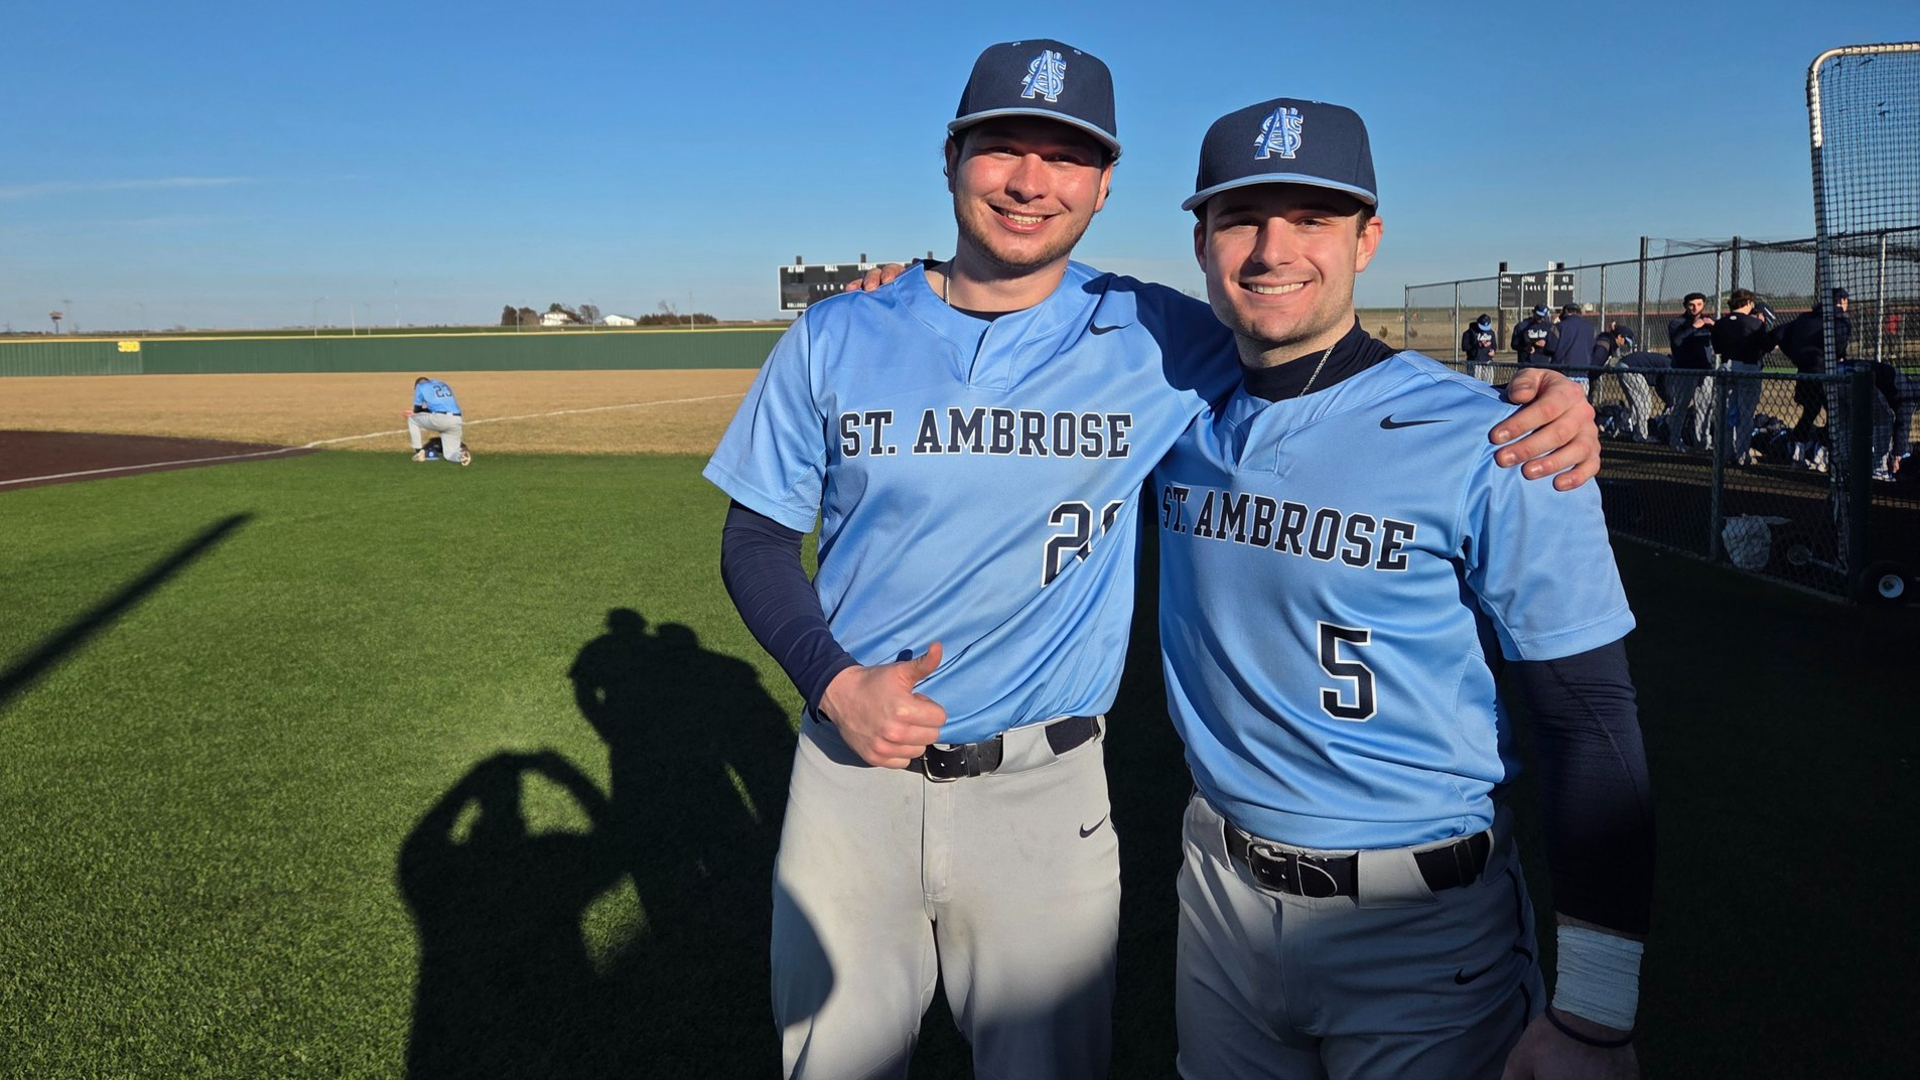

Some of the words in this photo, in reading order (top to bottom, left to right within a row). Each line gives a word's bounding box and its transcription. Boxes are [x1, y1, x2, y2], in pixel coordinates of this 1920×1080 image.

[433, 384, 453, 398] 23
[839, 409, 897, 458] ST.
[912, 407, 1133, 460] AMBROSE
[1162, 485, 1191, 534] ST.
[1193, 490, 1417, 571] AMBROSE
[1317, 620, 1377, 722] 5
